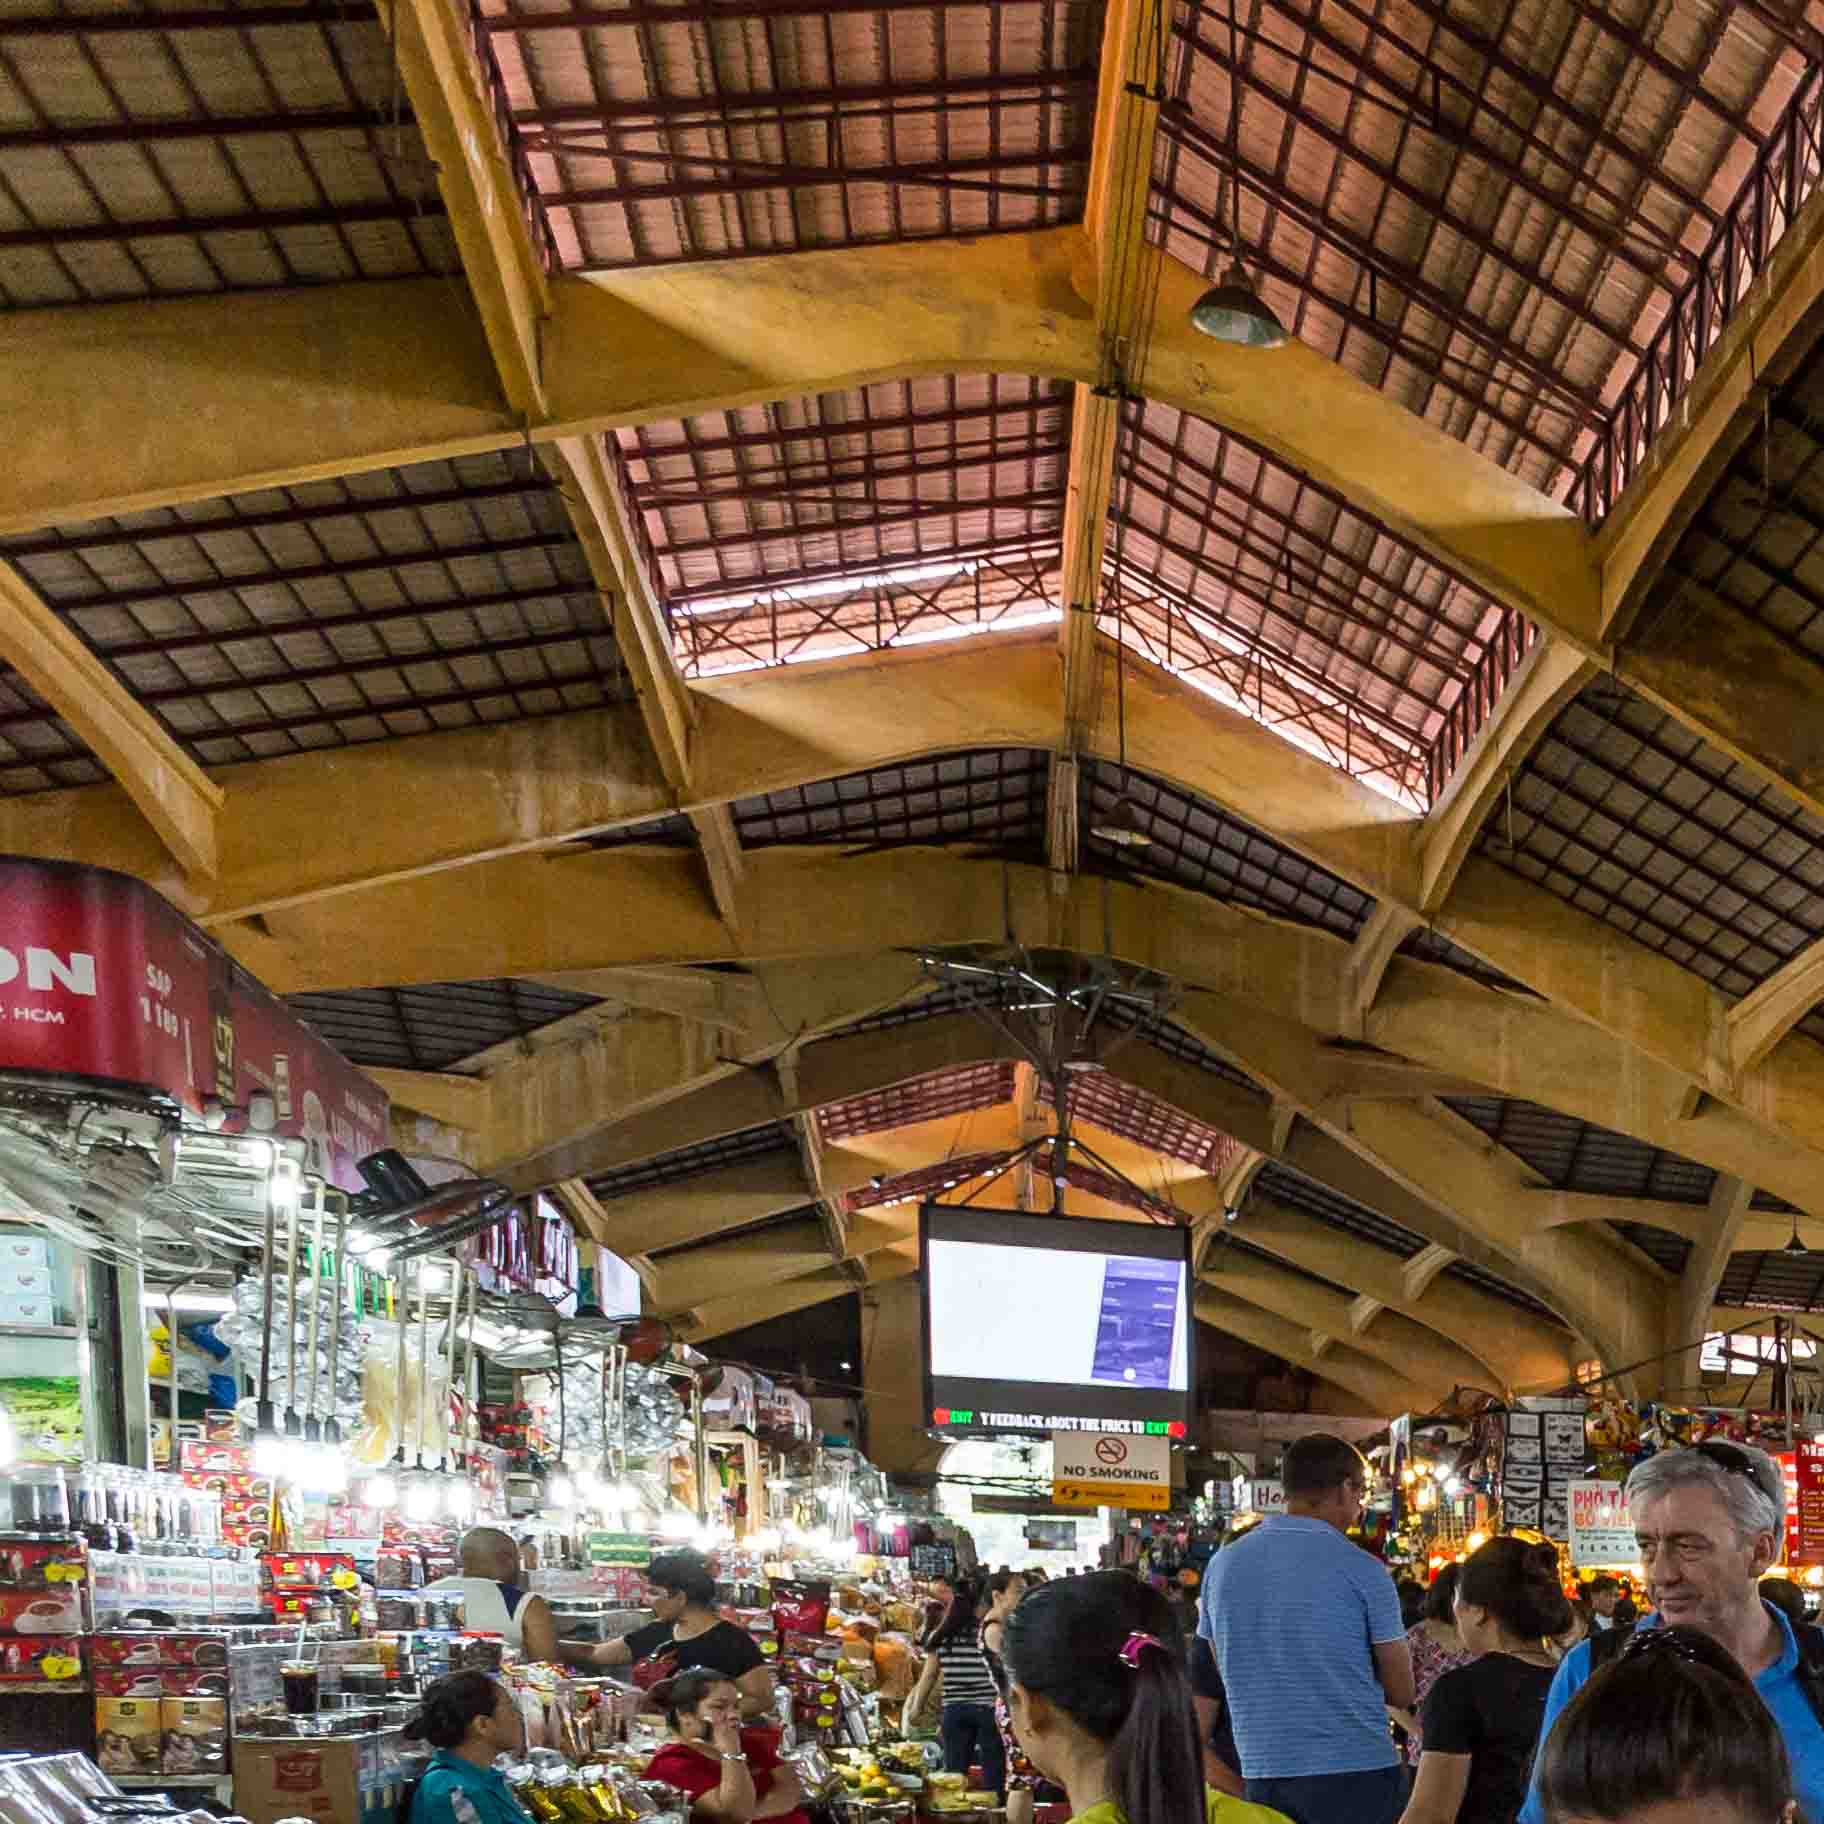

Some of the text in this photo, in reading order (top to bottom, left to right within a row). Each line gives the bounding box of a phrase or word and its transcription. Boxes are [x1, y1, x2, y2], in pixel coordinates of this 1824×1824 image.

[14, 1008, 64, 1024] HCM
[1063, 1465, 1160, 1480] NO SMOKING
